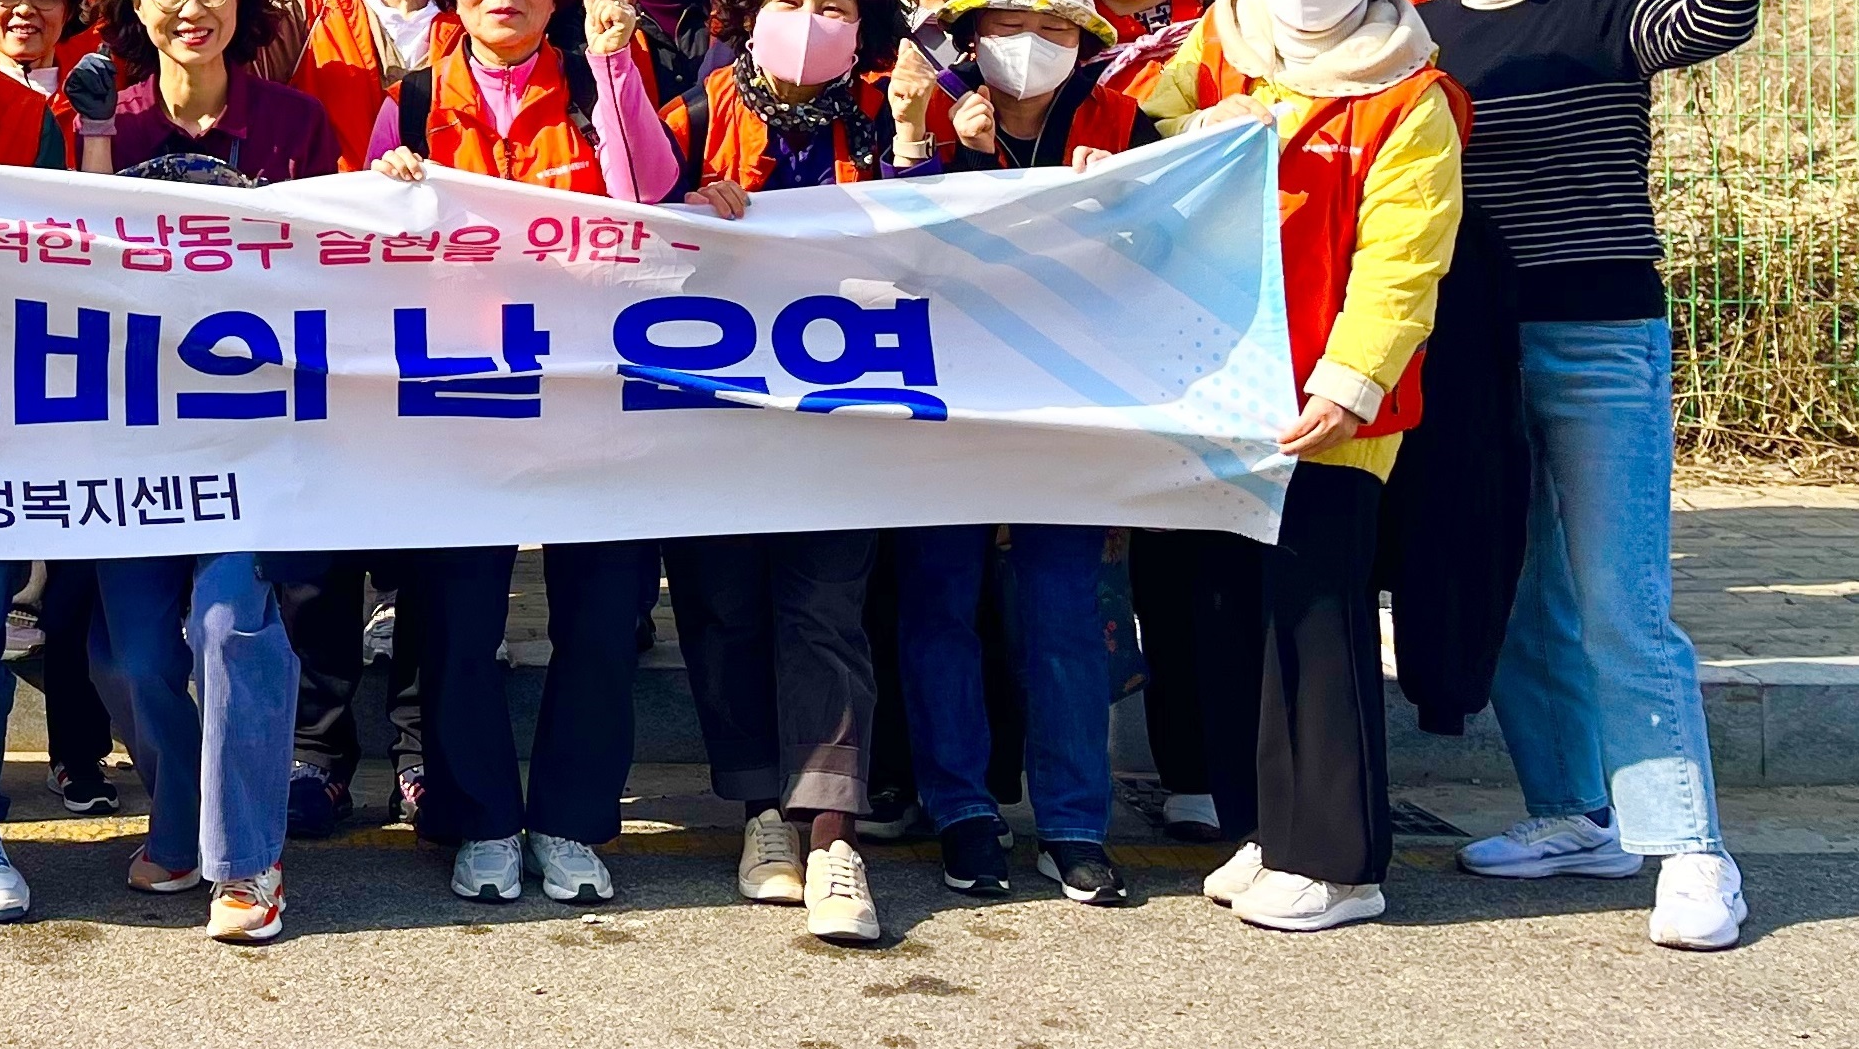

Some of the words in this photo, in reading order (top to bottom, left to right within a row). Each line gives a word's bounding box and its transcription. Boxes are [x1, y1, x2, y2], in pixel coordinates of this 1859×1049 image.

[115, 214, 294, 273] 남동구
[316, 225, 503, 266] 실현을
[522, 216, 651, 264] 위한
[393, 303, 550, 418] 날
[613, 295, 948, 422] 운영
